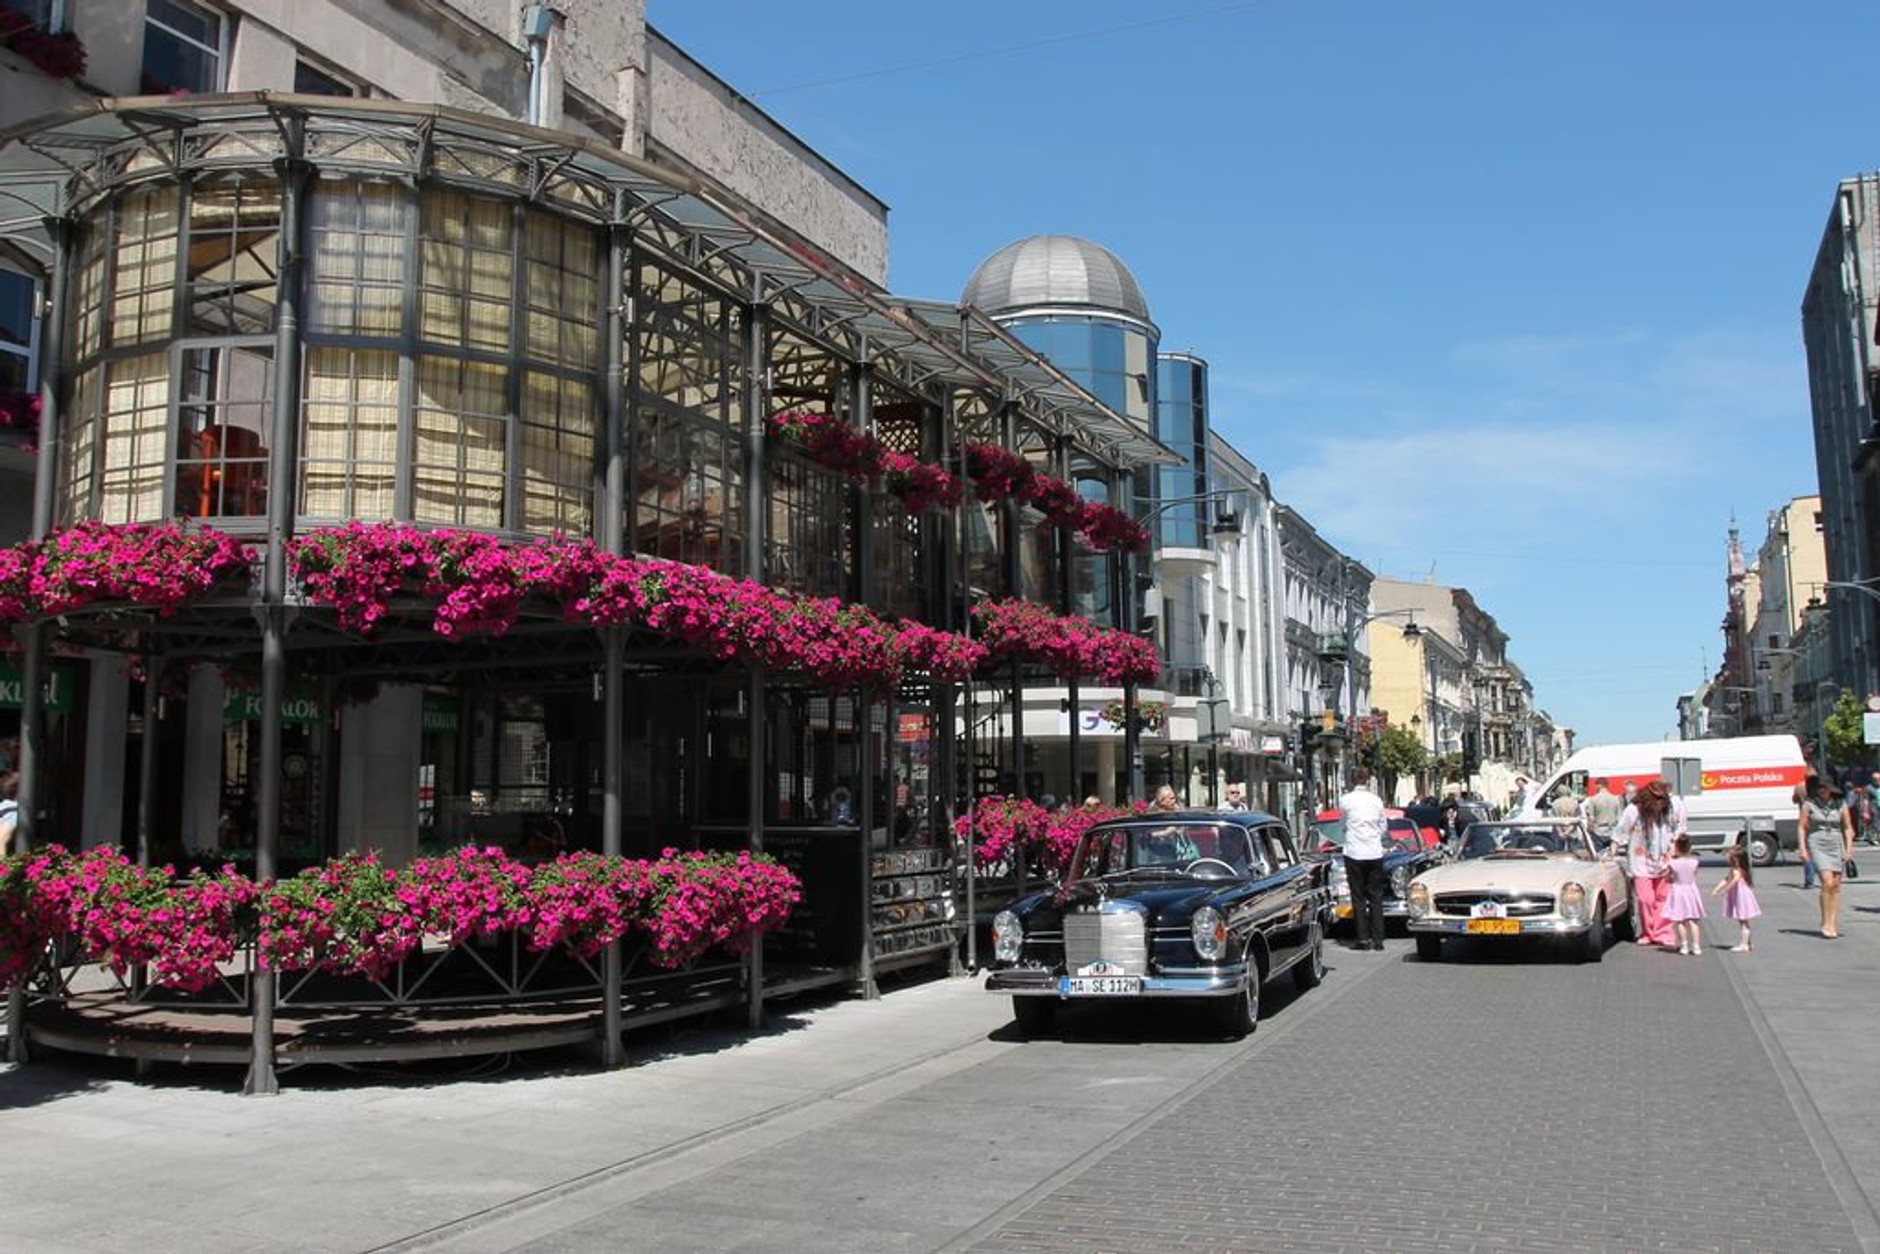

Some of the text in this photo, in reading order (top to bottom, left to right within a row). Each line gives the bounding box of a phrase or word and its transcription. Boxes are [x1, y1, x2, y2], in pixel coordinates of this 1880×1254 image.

[1720, 773, 1784, 785] Poczta Polska
[1070, 980, 1084, 993] MA
[1092, 979, 1106, 993] SE
